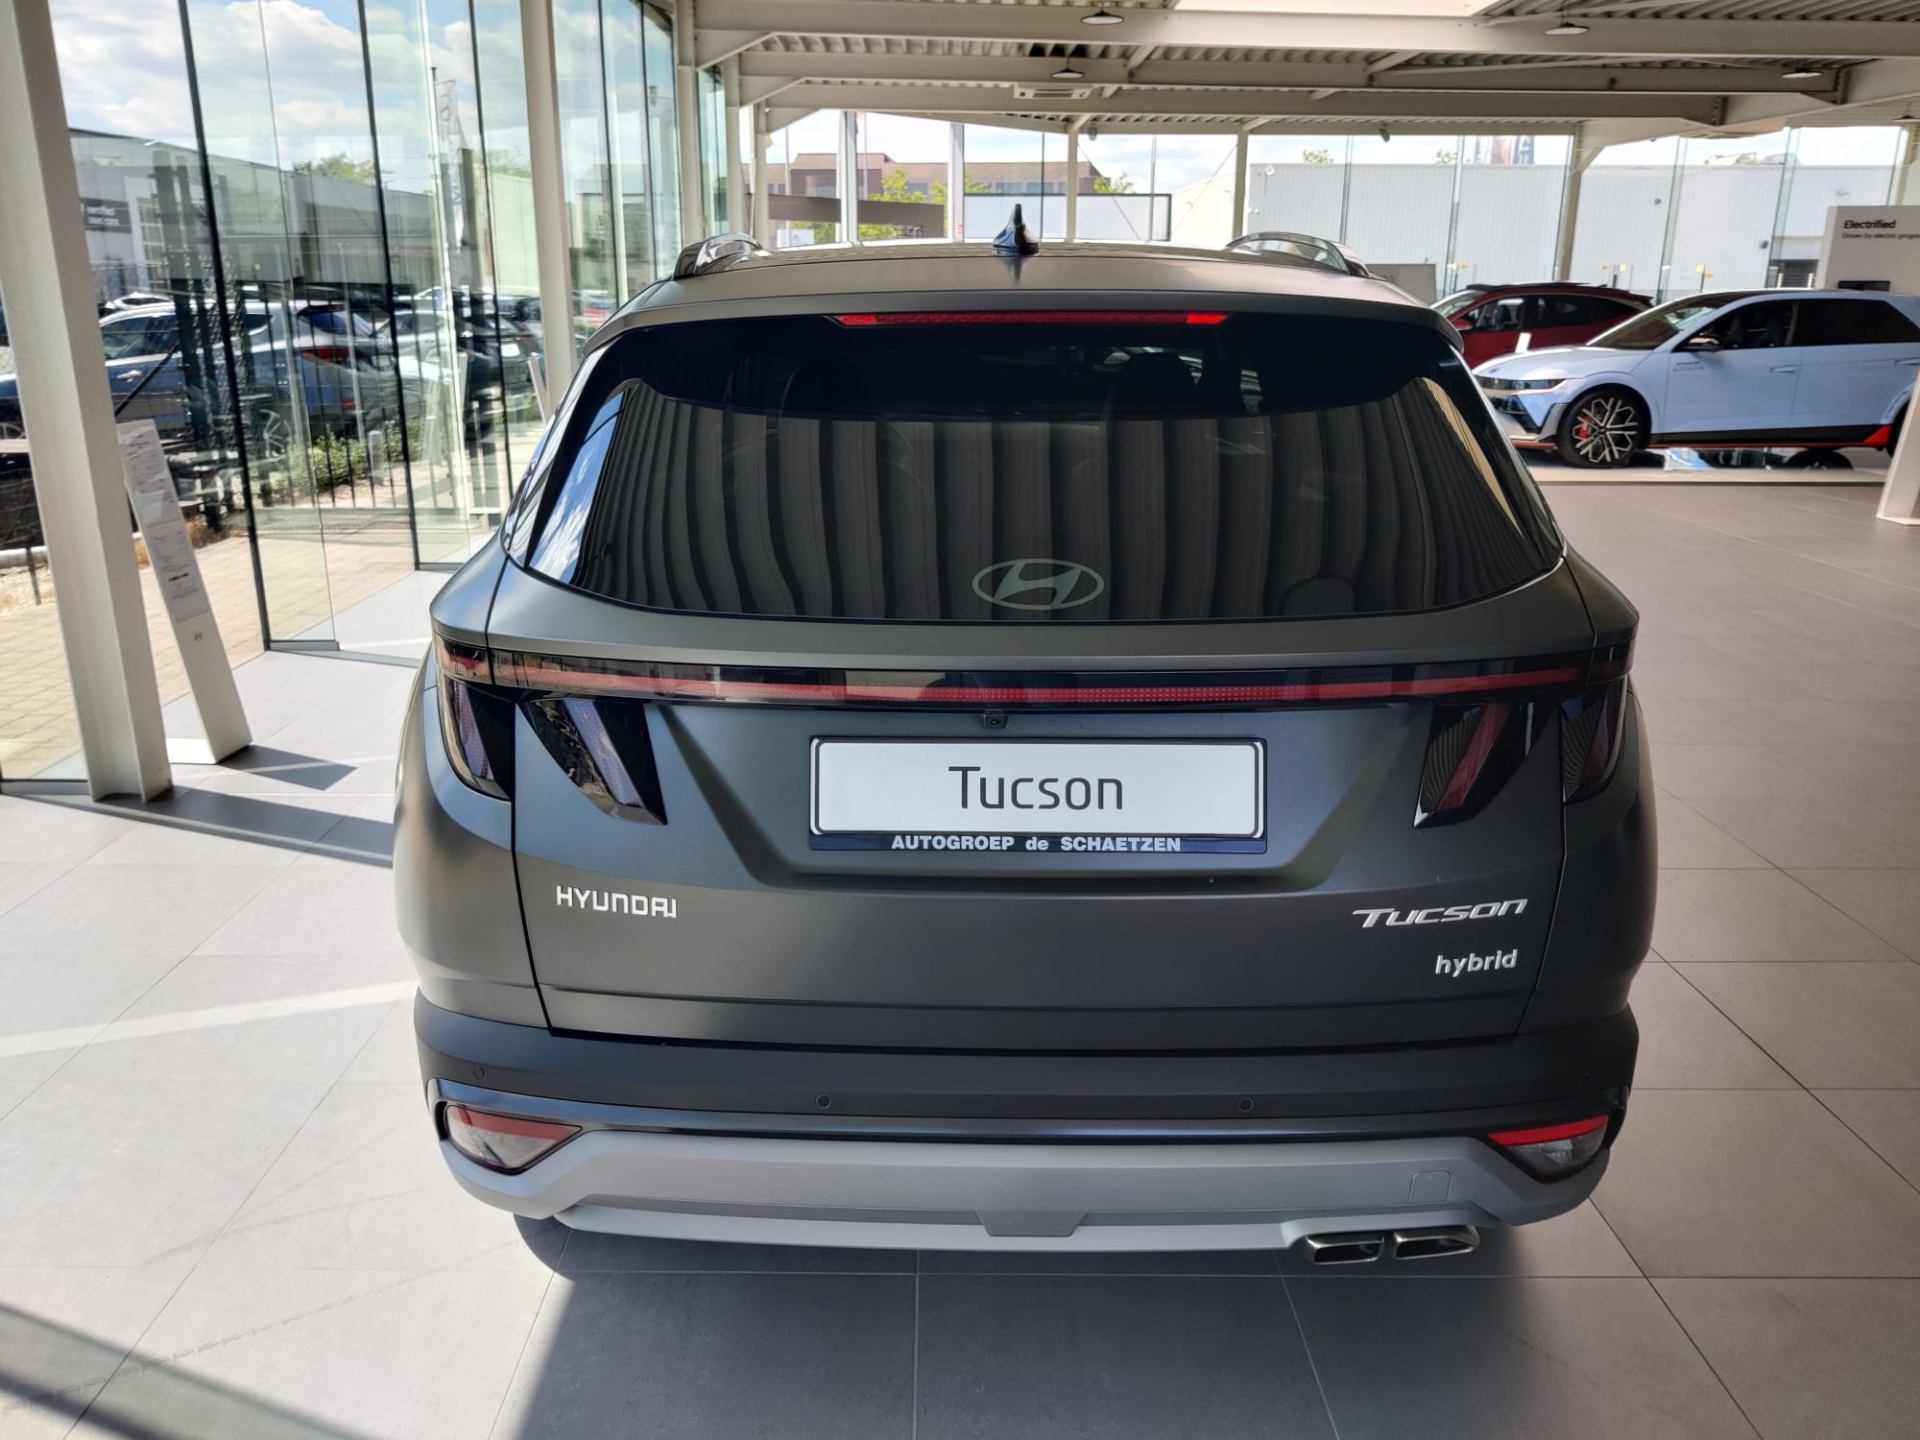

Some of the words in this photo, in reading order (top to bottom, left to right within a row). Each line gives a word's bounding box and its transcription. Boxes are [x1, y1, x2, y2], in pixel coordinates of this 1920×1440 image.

[1843, 219, 1896, 229] Electrified
[948, 766, 1122, 811] Tucson
[892, 836, 1014, 851] AUTOGROEP
[1026, 836, 1049, 851] de
[1061, 837, 1181, 852] SCHAETZEN
[556, 885, 677, 919] HYUNDAI
[1435, 949, 1519, 978] hybrid
